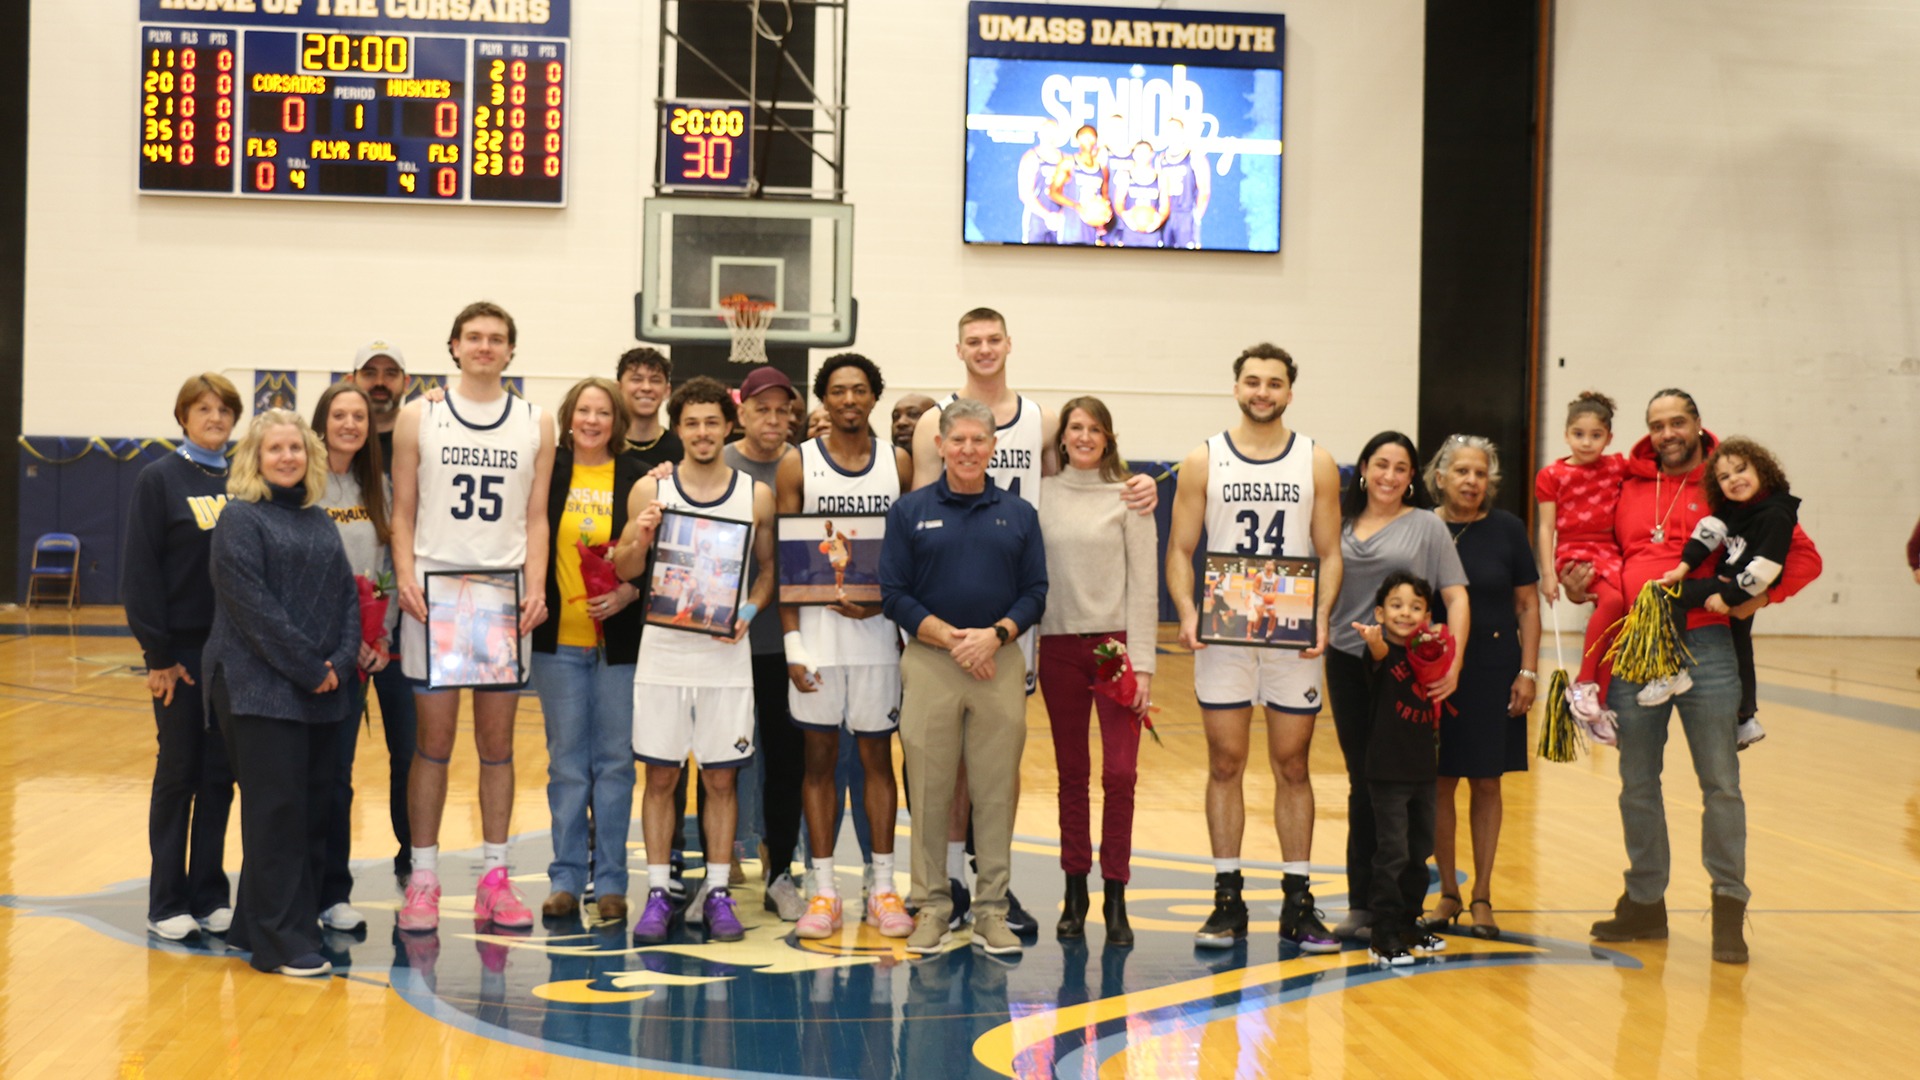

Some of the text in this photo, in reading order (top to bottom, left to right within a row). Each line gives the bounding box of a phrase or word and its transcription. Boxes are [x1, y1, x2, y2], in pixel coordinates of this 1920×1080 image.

[384, 0, 551, 24] CORSAIRS
[147, 29, 173, 44] PLYR
[978, 14, 1276, 52] UMASS DARTMOUTH
[151, 48, 233, 72] 11 0 0
[302, 33, 408, 73] 20:00
[144, 70, 232, 96] 20 0 0
[252, 73, 326, 94] CORSAIRS
[490, 59, 562, 84] 2 0 0
[333, 86, 376, 100] PERIOD
[387, 78, 451, 98] HUSKIES
[491, 82, 561, 107] 3 0 0
[143, 94, 231, 119] 21 0 0
[282, 96, 306, 133] 0
[354, 103, 364, 130] 1
[474, 105, 560, 130] 21 0 0
[145, 117, 231, 143] 35 0 0
[435, 101, 458, 138] 0
[670, 107, 745, 137] 20:00
[247, 138, 277, 158] FLS
[311, 139, 397, 162] PLYR FOUL
[428, 143, 459, 164] FLS
[473, 129, 560, 154] 22 0 0
[143, 142, 230, 167] 44 0 0
[473, 152, 560, 178] 23 0 0
[682, 135, 733, 180] 30
[255, 161, 276, 191] 0
[289, 169, 306, 190] 4
[399, 173, 416, 193] 4
[437, 166, 457, 197] 0
[441, 446, 518, 470] CORSAIRS
[986, 449, 1031, 469] SAIRS
[450, 473, 505, 522] 35
[818, 495, 890, 514] CORSAIRS
[1222, 482, 1301, 503] CORSAIRS
[1235, 509, 1286, 556] 34
